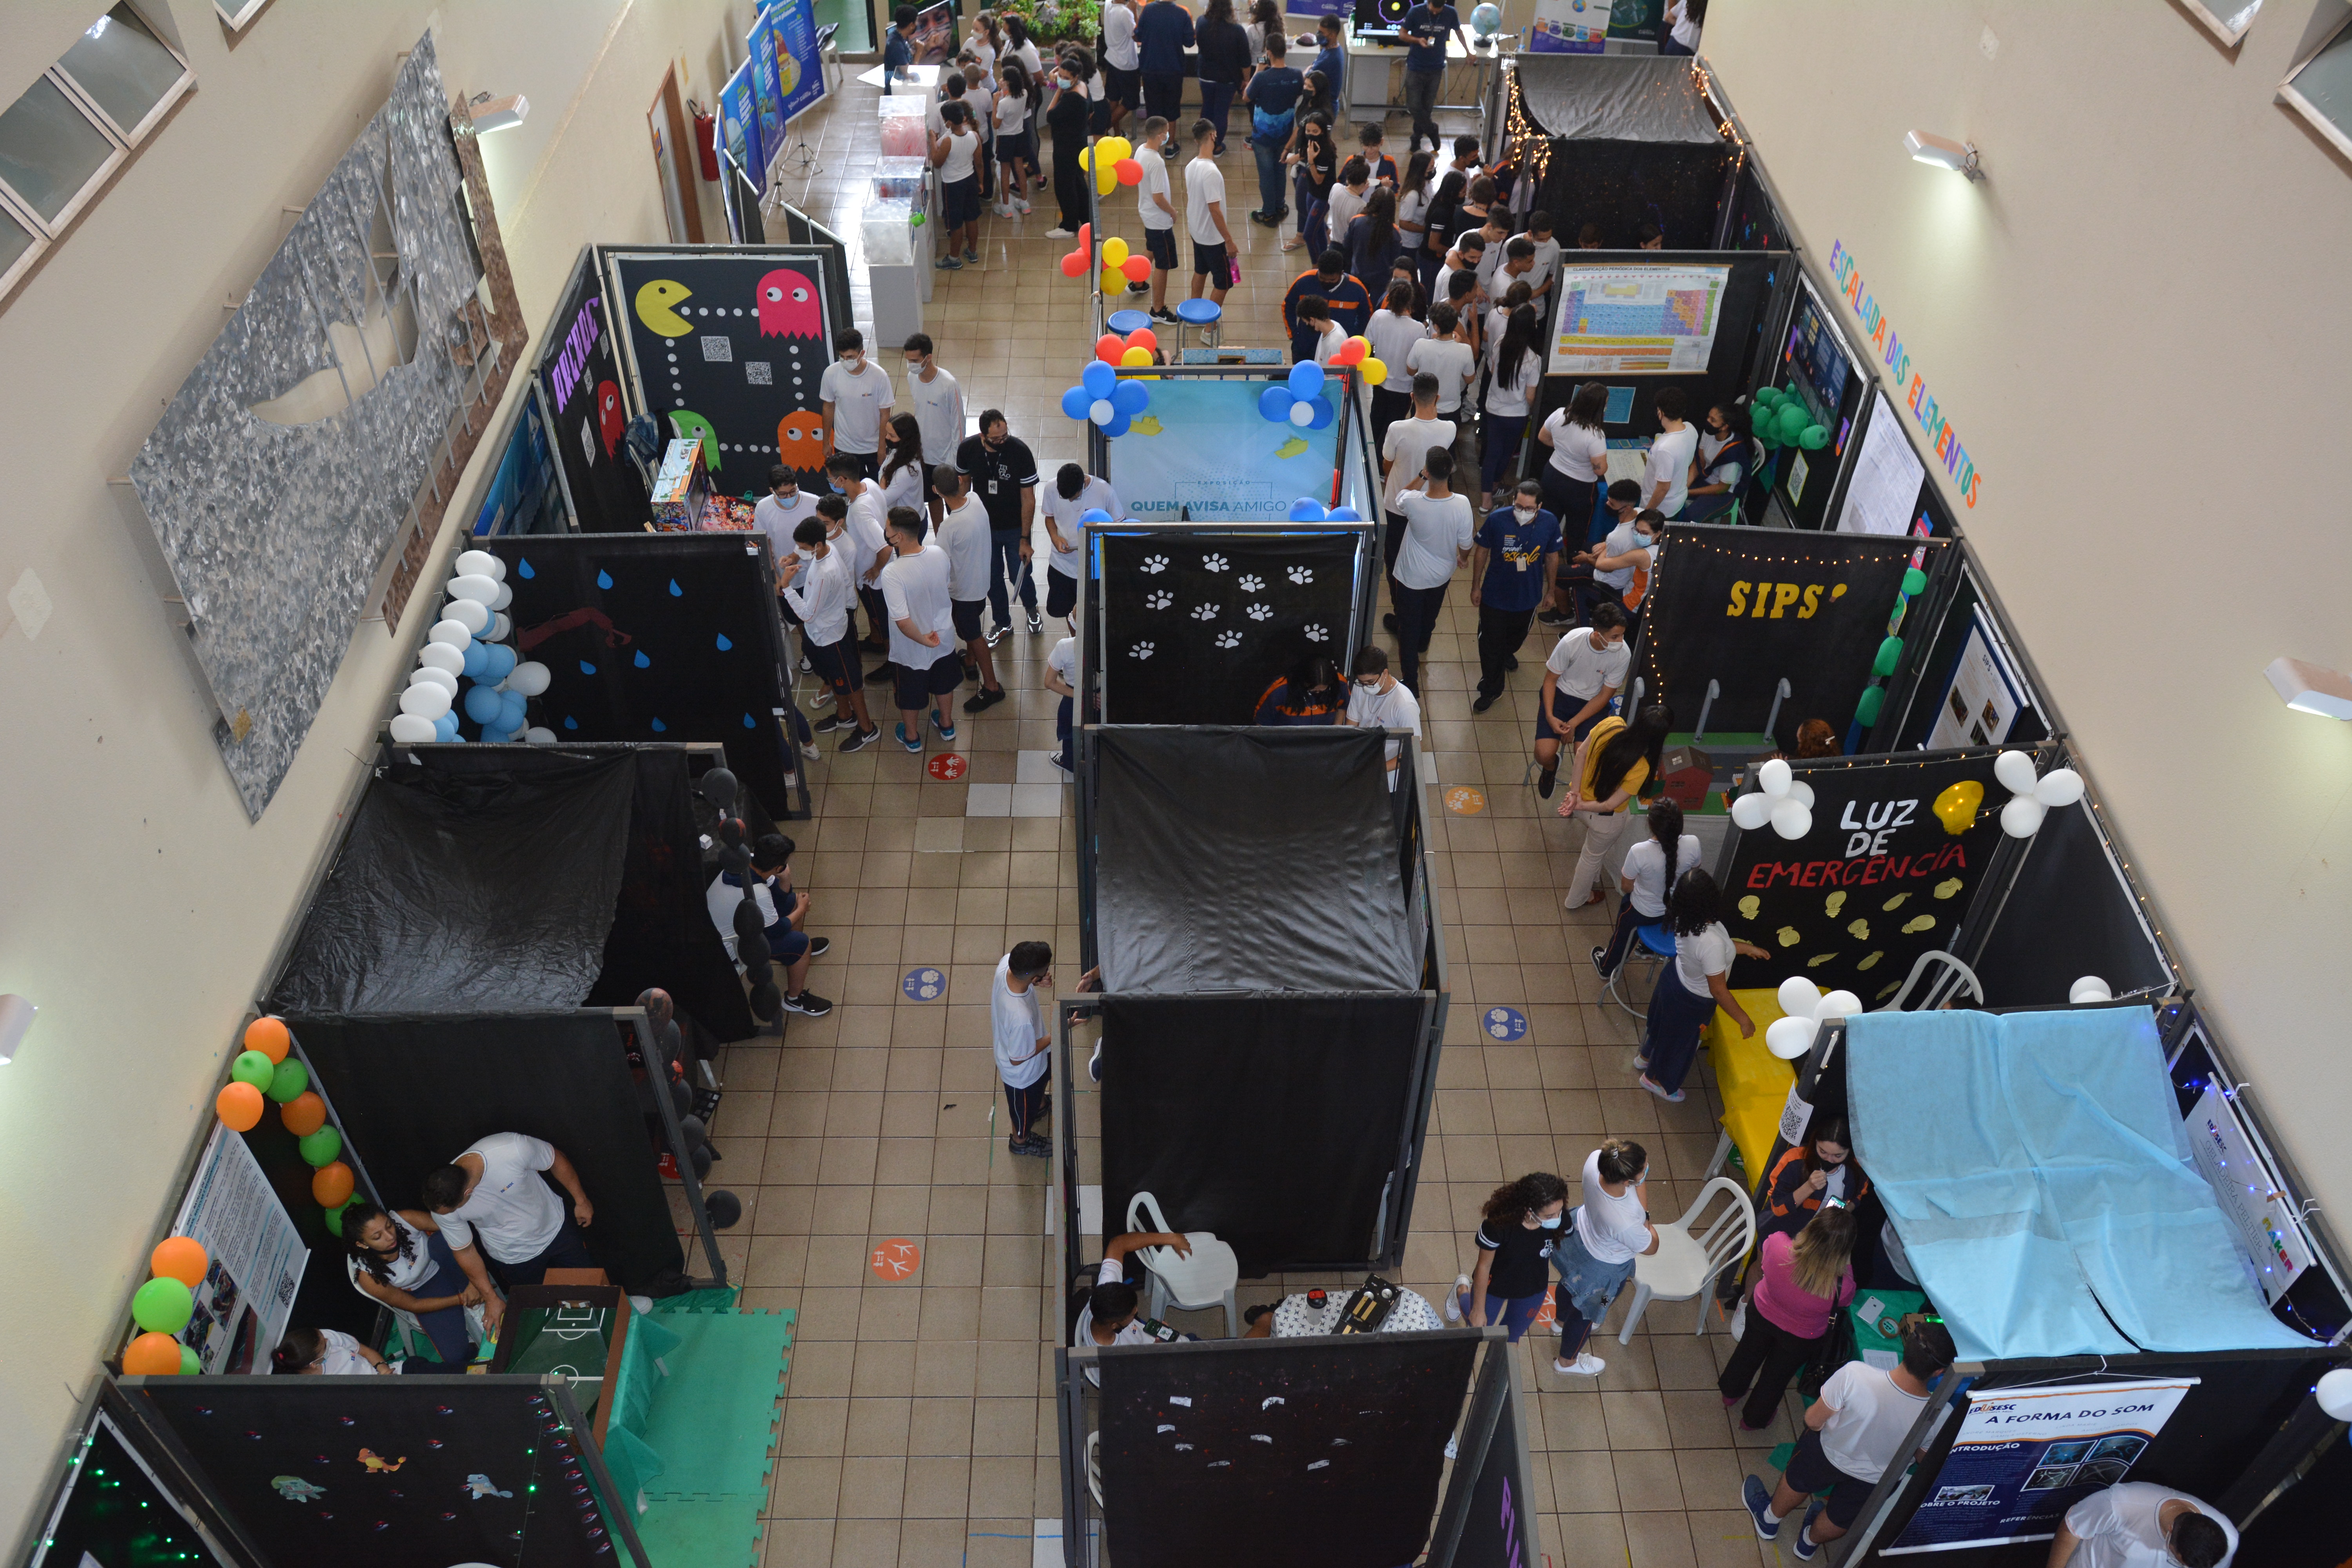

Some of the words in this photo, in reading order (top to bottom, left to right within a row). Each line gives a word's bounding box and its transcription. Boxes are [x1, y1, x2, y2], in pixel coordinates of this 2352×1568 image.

[552, 297, 599, 414] ARCADE
[1829, 239, 1887, 352] ESCALADA
[1885, 331, 1910, 385] DOS
[1907, 373, 1982, 509] ELEMENTOS
[1131, 501, 1179, 512] QUEM
[1185, 501, 1230, 512] AVISA
[1233, 501, 1287, 512] AMIGO
[1726, 580, 1824, 619] SIPS
[1982, 654, 1992, 672] SIPS
[1840, 799, 1919, 830] LUZ
[1845, 828, 1898, 858] DE
[1746, 843, 1966, 888] EMERGÊNCIA
[2205, 1140, 2239, 1203] GELADEIRA
[2237, 1202, 2263, 1250] PELTIER
[2262, 1217, 2293, 1272] MAKER
[1968, 1402, 2016, 1415] EDUSESC
[1985, 1416, 1999, 1424] A
[2005, 1412, 2072, 1424] FORMA
[2077, 1409, 2107, 1419] DO
[2111, 1404, 2154, 1416] SOM
[1950, 1443, 2020, 1454] NTRODUÇÃO
[2000, 1513, 2060, 1524] REFERÊNCIAS
